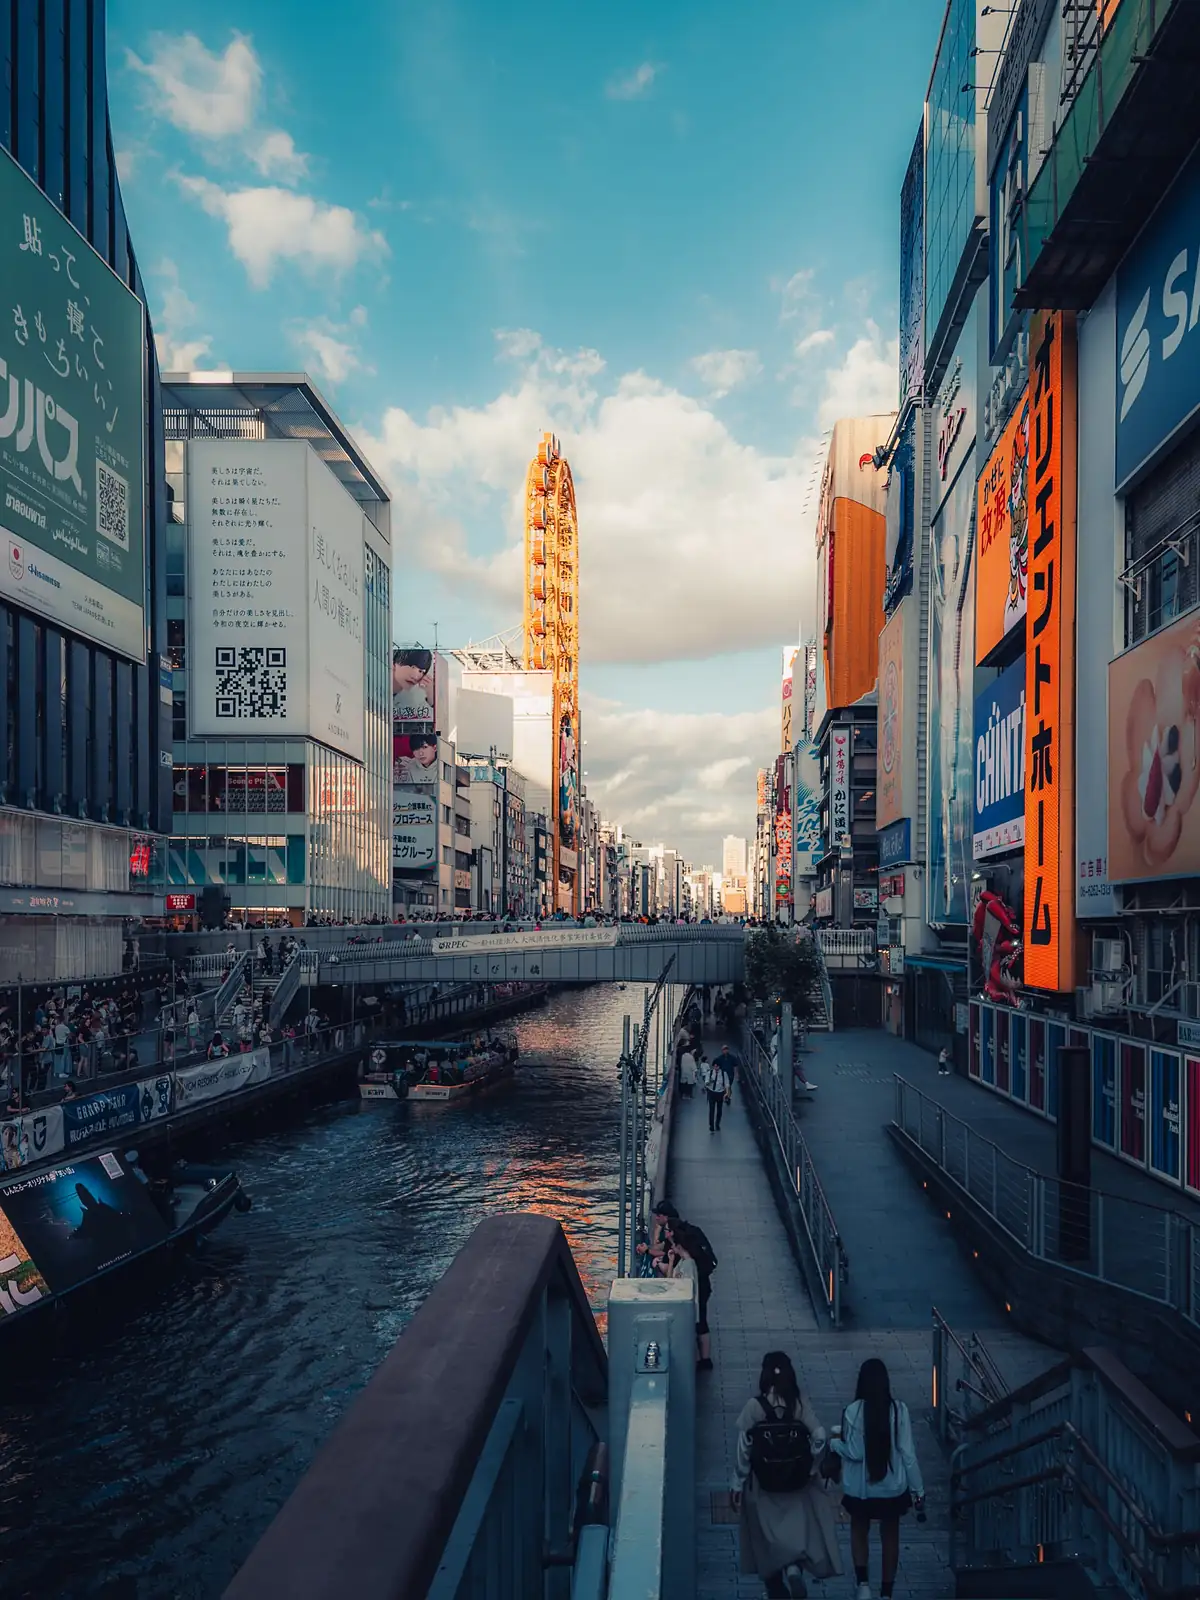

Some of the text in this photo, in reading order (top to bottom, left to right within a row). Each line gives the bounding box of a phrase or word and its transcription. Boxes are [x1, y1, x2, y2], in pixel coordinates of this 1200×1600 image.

[211, 467, 263, 476] 美しさは宇宙だ。
[211, 478, 267, 487] それは果てしない。
[211, 497, 281, 506] 美しさは瞬く星たちだ。
[981, 481, 1005, 557] 改源
[211, 520, 273, 528] それぞれに光り輝く。
[212, 538, 256, 547] 美しさは愛だ。
[212, 549, 287, 558] それは、魂を豊かにする。
[212, 568, 273, 576] あなたにはあなたの
[212, 579, 272, 587] わたしにはわたしの
[212, 590, 254, 598] 美しさがある。
[213, 620, 287, 628] 令和の夜空に輝かせる。
[1031, 317, 1055, 946] オリエントホーム
[783, 703, 792, 750] バイト
[393, 813, 433, 825] プロデュース
